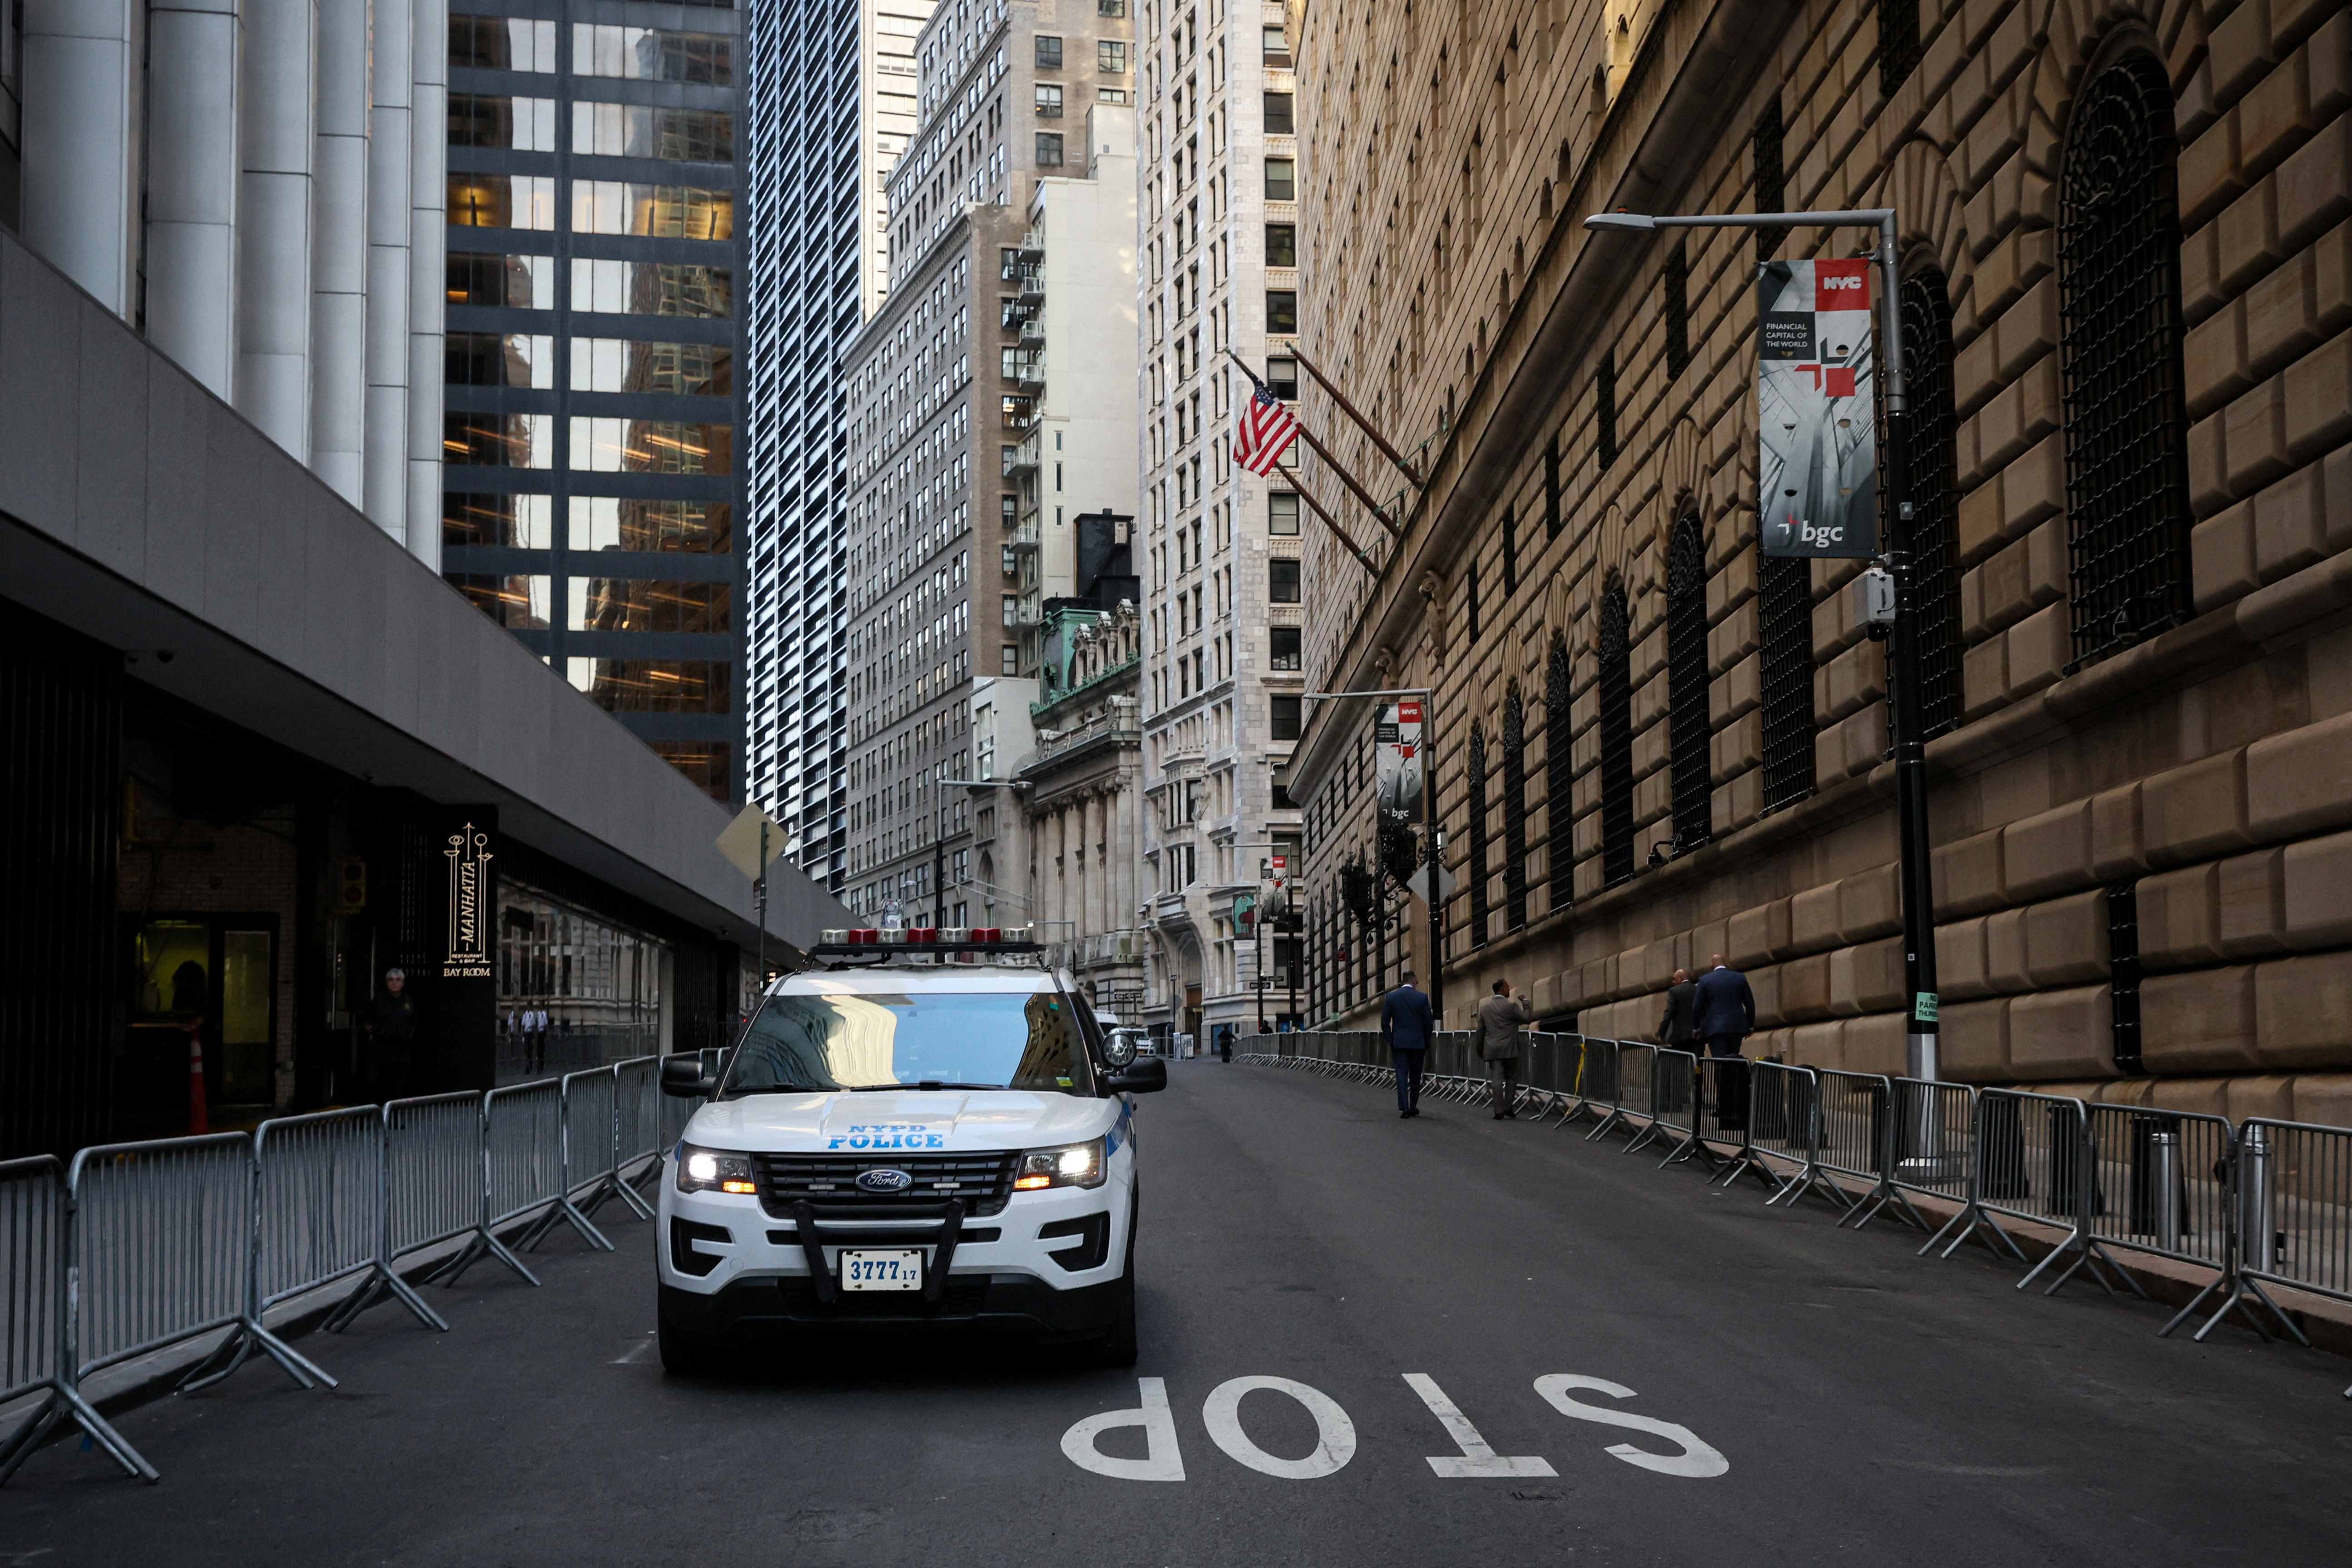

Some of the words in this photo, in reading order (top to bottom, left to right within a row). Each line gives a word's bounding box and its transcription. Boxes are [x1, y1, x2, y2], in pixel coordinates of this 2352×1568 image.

[1823, 276, 1862, 290] NYC
[1801, 520, 1843, 548] bgc
[1392, 807, 1409, 820] bgc
[461, 862, 475, 943] MANHATTA
[444, 968, 461, 977] BAY
[463, 968, 490, 977] ROOM
[828, 1134, 943, 1149] POLICE
[867, 1172, 900, 1186] Ford
[851, 1261, 899, 1280] 3777
[902, 1270, 916, 1280] 17
[1060, 1373, 1730, 1481] STOP
